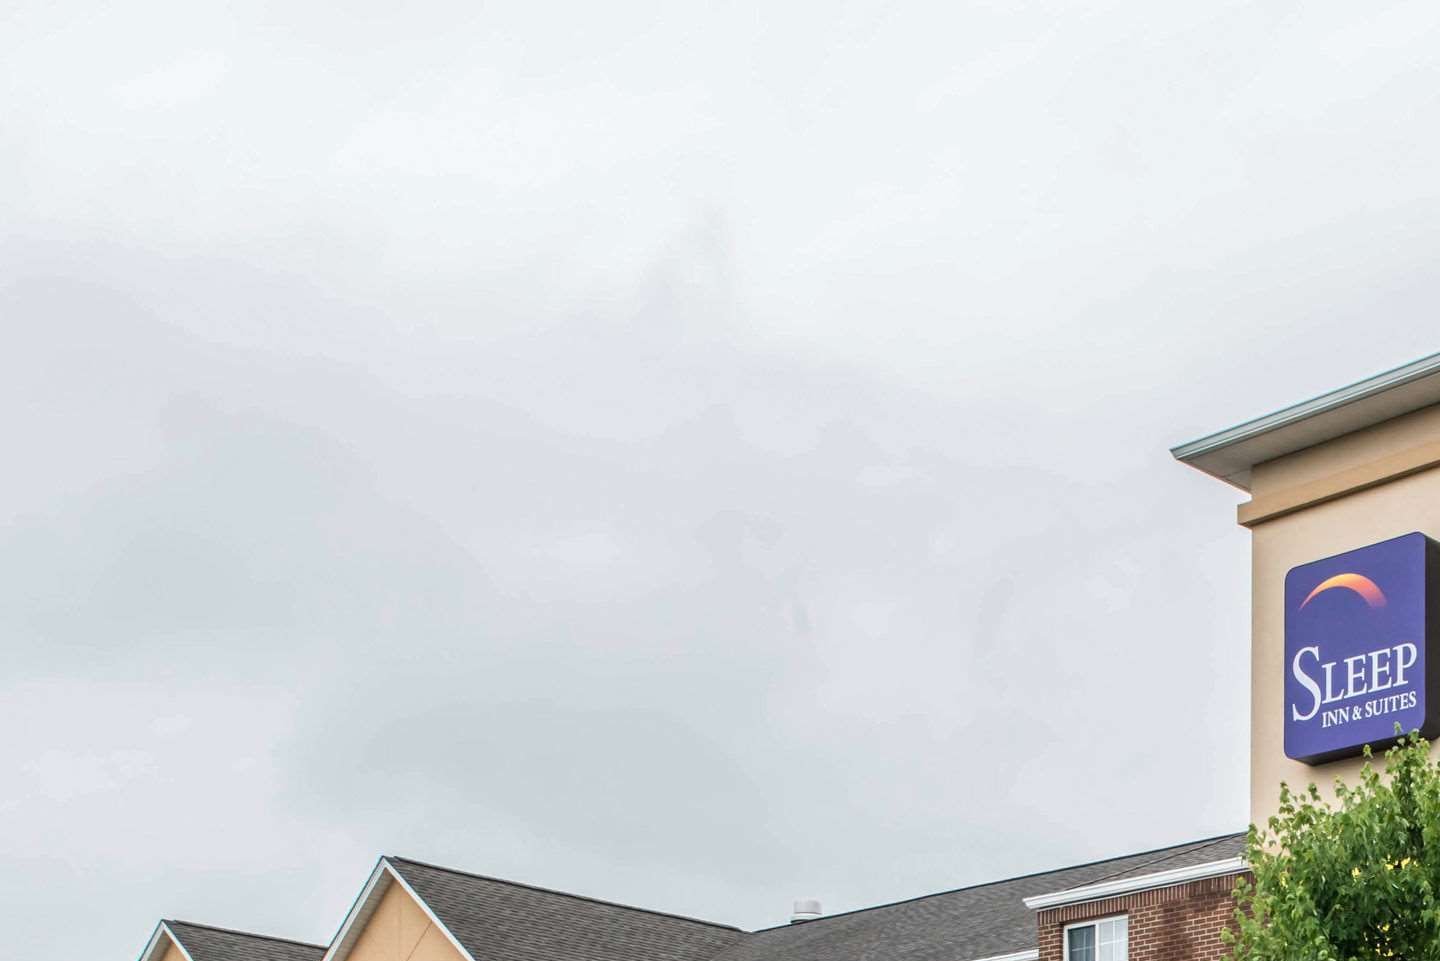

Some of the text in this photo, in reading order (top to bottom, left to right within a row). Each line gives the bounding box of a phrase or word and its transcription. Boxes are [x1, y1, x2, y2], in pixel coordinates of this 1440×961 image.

[1292, 642, 1418, 721] SLEEP
[1322, 691, 1417, 728] INN & SUITES
